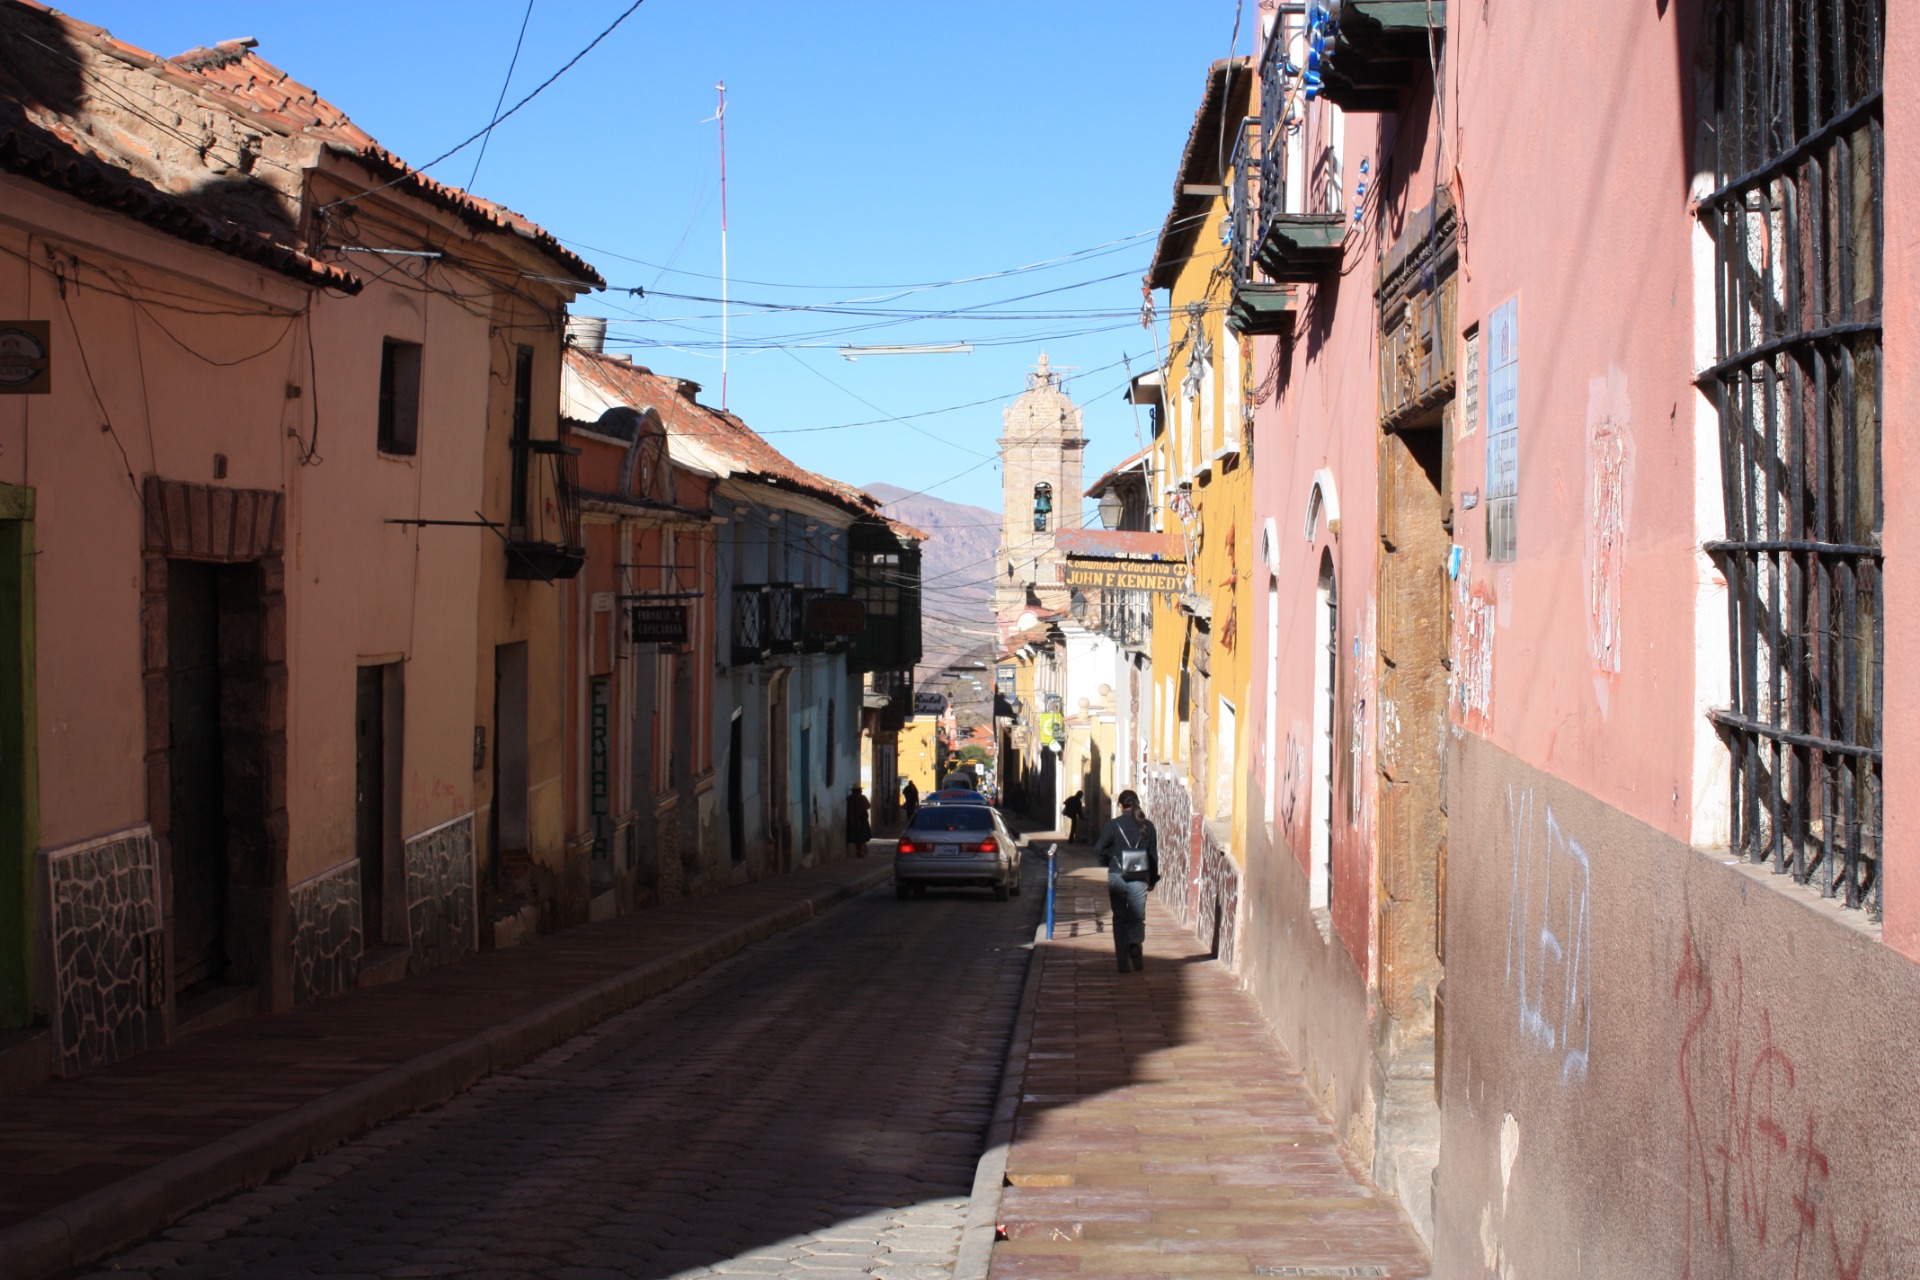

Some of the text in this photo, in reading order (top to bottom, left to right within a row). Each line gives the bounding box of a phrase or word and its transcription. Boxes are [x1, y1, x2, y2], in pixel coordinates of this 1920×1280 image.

[1067, 560, 1170, 575] Comunidad Educativa
[1066, 570, 1103, 586] JOHN
[1117, 573, 1185, 591] KENNEDY
[638, 609, 671, 621] FARMACIA
[591, 681, 608, 860] FARMACIA
